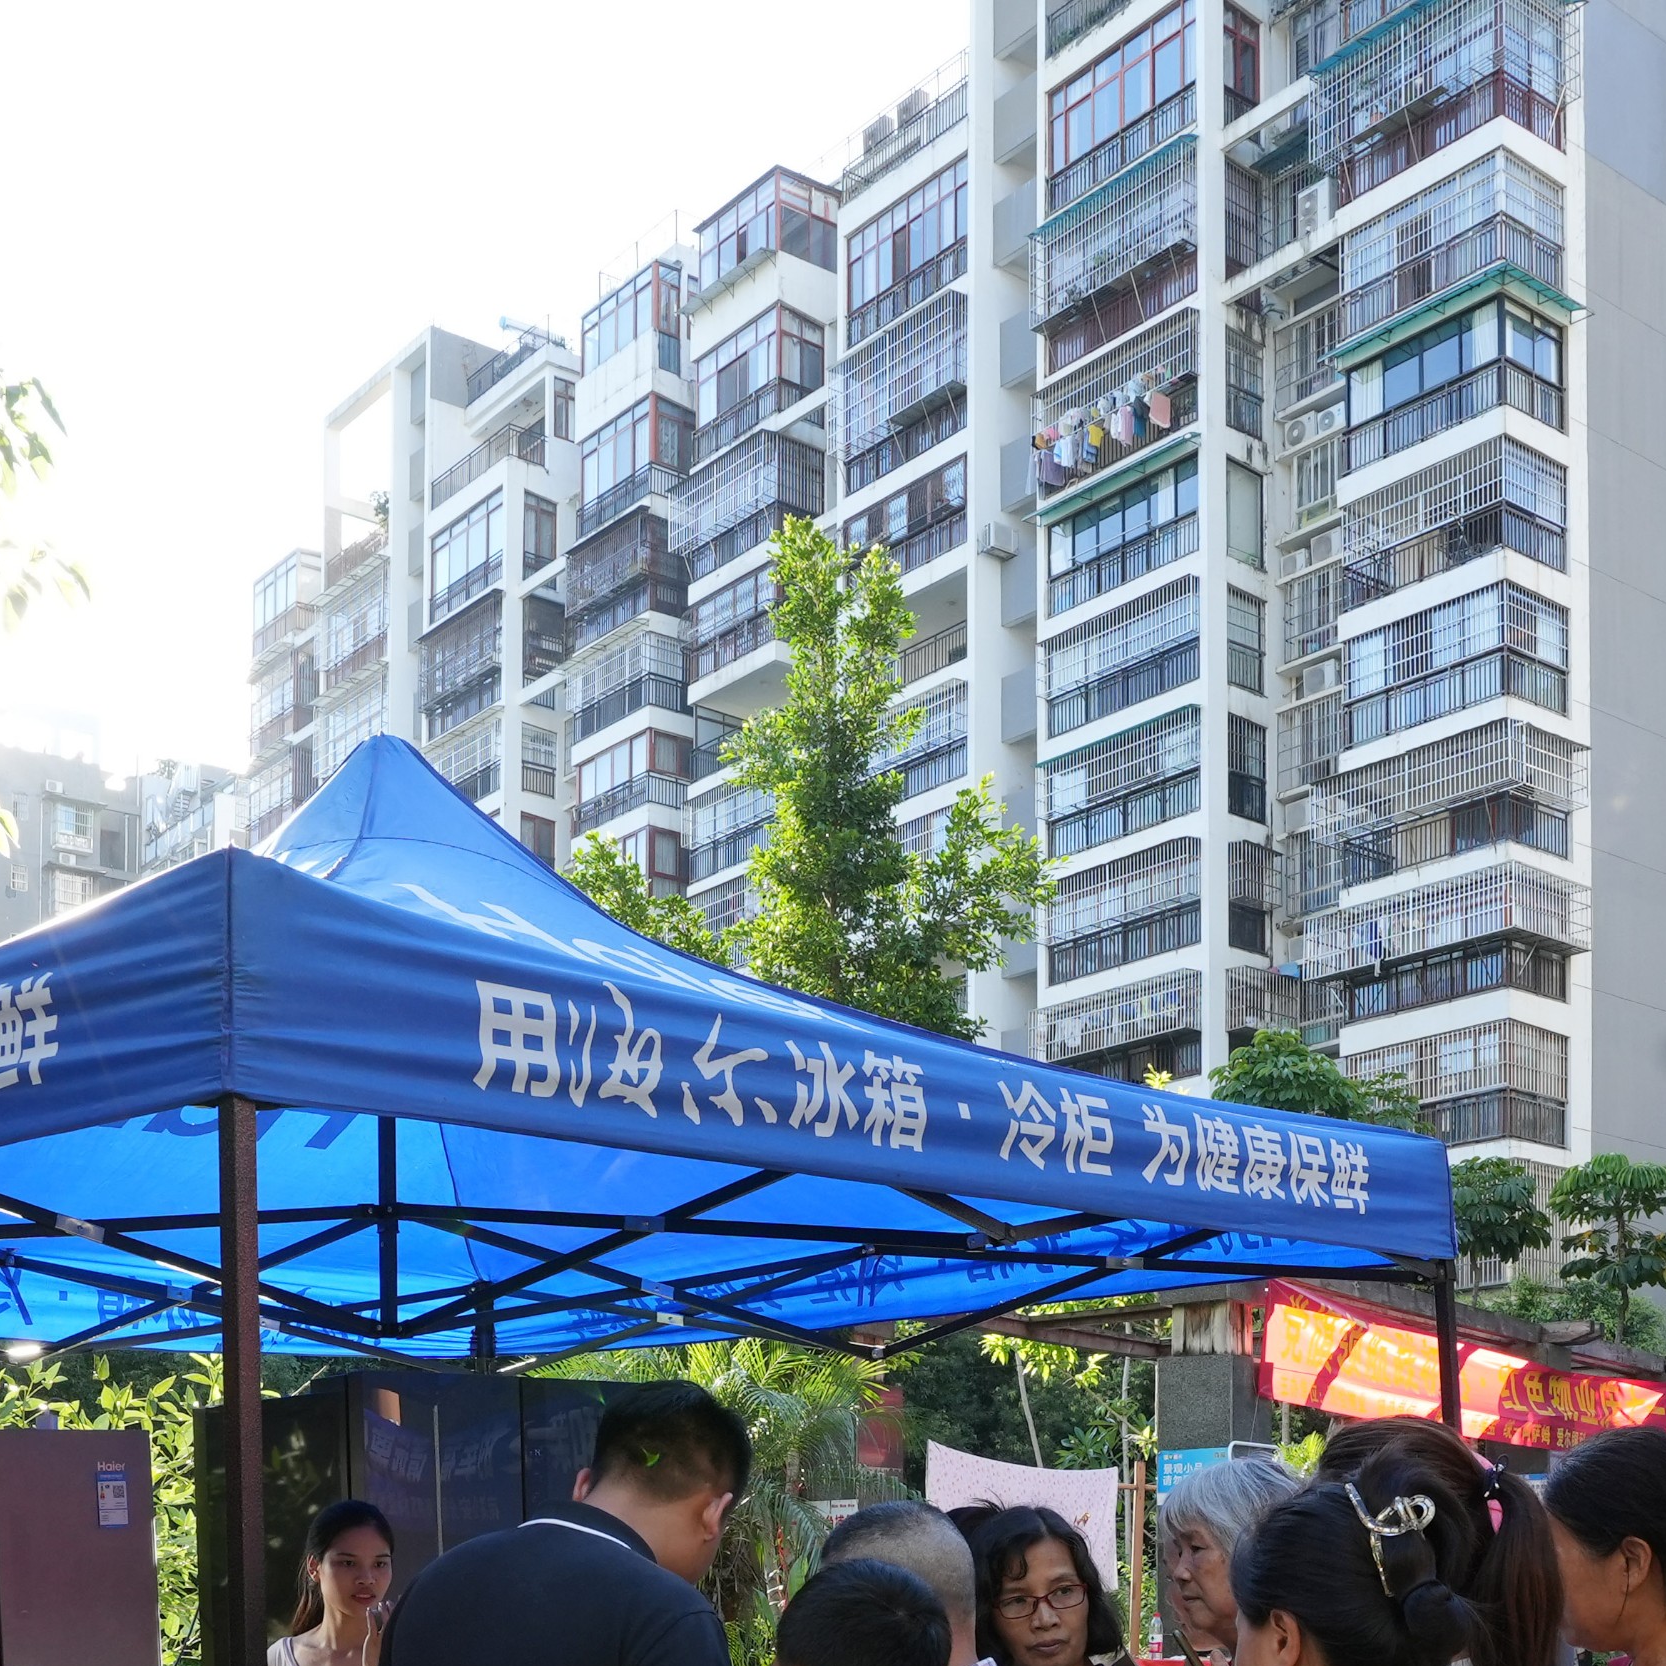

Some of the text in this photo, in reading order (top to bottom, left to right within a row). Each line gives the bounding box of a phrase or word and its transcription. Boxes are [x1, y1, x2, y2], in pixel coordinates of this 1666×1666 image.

[1139, 1105, 1369, 1216] 为健康保鲜
[97, 1460, 125, 1472] Haier
[1163, 1475, 1190, 1487] 请勿
